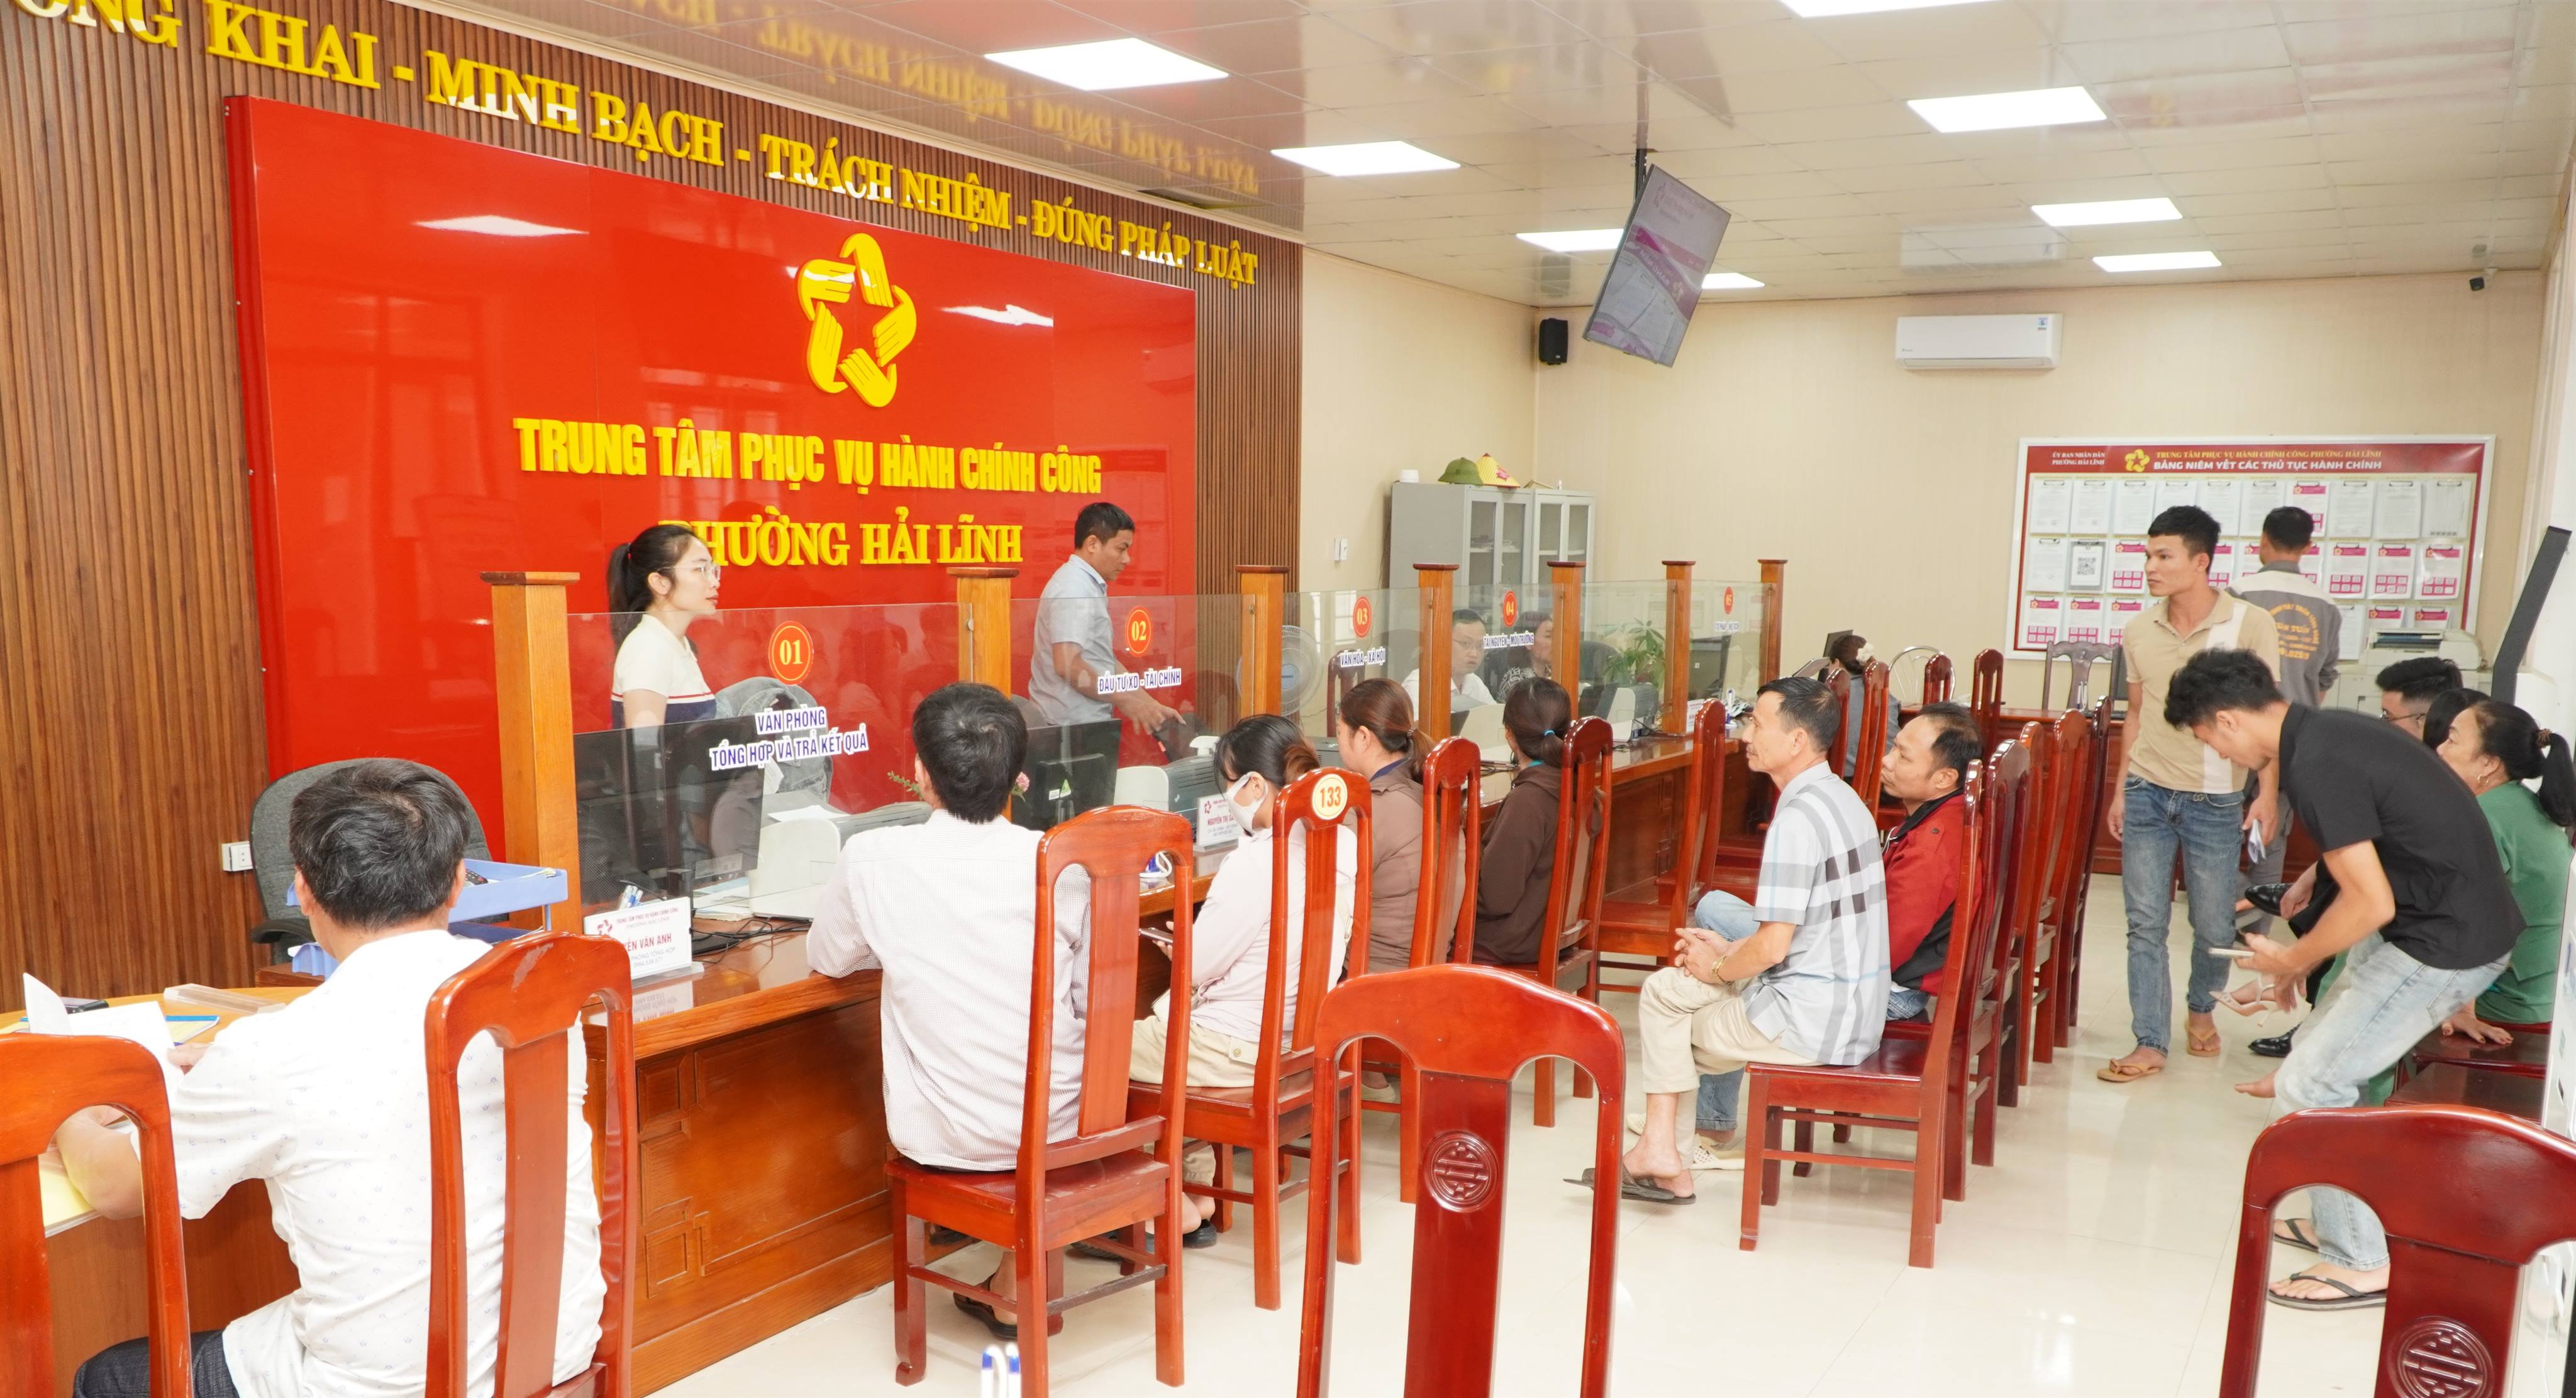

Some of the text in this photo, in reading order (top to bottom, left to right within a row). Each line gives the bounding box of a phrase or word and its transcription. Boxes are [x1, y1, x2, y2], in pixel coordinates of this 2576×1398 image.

[206, 0, 381, 89] KHAI
[425, 50, 582, 135] MINH
[591, 91, 724, 167] BẠCH
[760, 134, 895, 205] TRÁCH
[899, 168, 1012, 233] NHIỆM
[1032, 196, 1115, 252] ĐÚNG
[1119, 221, 1191, 269] PHÁP
[1194, 240, 1258, 289] LUẬT
[513, 418, 1102, 495] TRUNG TÂM PHỤC VỤ HÀNH CHÍNH CÔNG
[2153, 458, 2382, 471] BẢNG NIÊM YẾT CÁC THỦ TỤC HÀNH CHÍNH
[2201, 451, 2222, 459] PHỤC
[2224, 451, 2235, 459] VỤ
[2236, 450, 2258, 458] HÀNH
[2259, 450, 2285, 458] CHÍNH
[2286, 450, 2309, 458] CÔNG
[2311, 449, 2343, 458] PHƯỜNG
[658, 506, 1023, 566] HƯỜNG HẢI LĨNH
[1357, 607, 1368, 626] 03
[1506, 601, 1514, 617] 04
[1131, 620, 1147, 641] 02
[779, 639, 803, 665] 01
[1341, 650, 1352, 666] VĂN
[1353, 649, 1364, 665] HÓA
[1376, 646, 1385, 665] HỘI
[1099, 671, 1114, 692] ĐẦU
[1116, 675, 1128, 691] TƯ
[1144, 668, 1157, 687] TÀI
[1158, 667, 1181, 685] CHÍNH
[757, 704, 825, 732] VĂN PHÒNG
[712, 724, 867, 768] TỔNG HỢP VÀ TRẢ KẾT QUẢ
[1320, 786, 1341, 808] 133
[639, 935, 655, 950] VĂN
[657, 933, 672, 945] ANH
